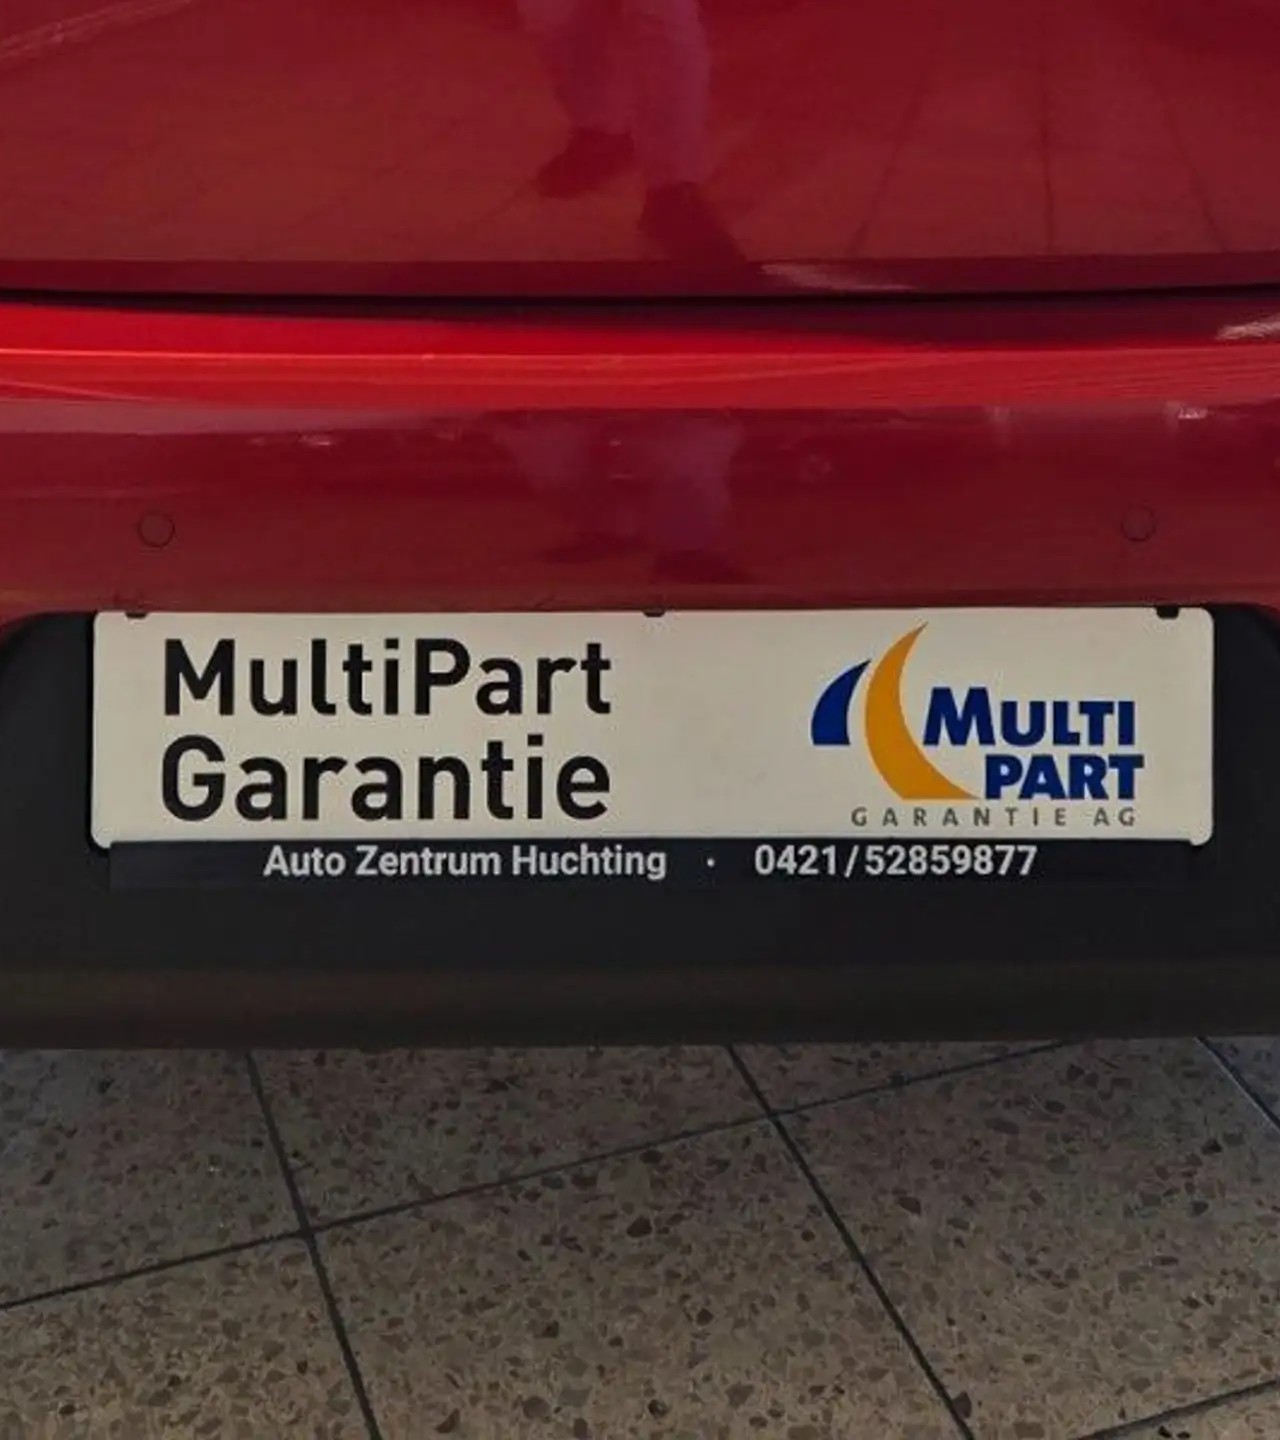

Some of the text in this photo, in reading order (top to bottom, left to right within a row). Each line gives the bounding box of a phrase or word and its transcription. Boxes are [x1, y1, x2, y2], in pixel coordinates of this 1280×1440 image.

[163, 638, 612, 716] MultiPart
[922, 686, 1136, 747] MULTI
[161, 733, 611, 822] Garantie
[984, 753, 1145, 801] PART
[850, 806, 1137, 828] GARANTIE AG
[262, 843, 1038, 883] Auto Zentrum Huchting 0421/52859877
